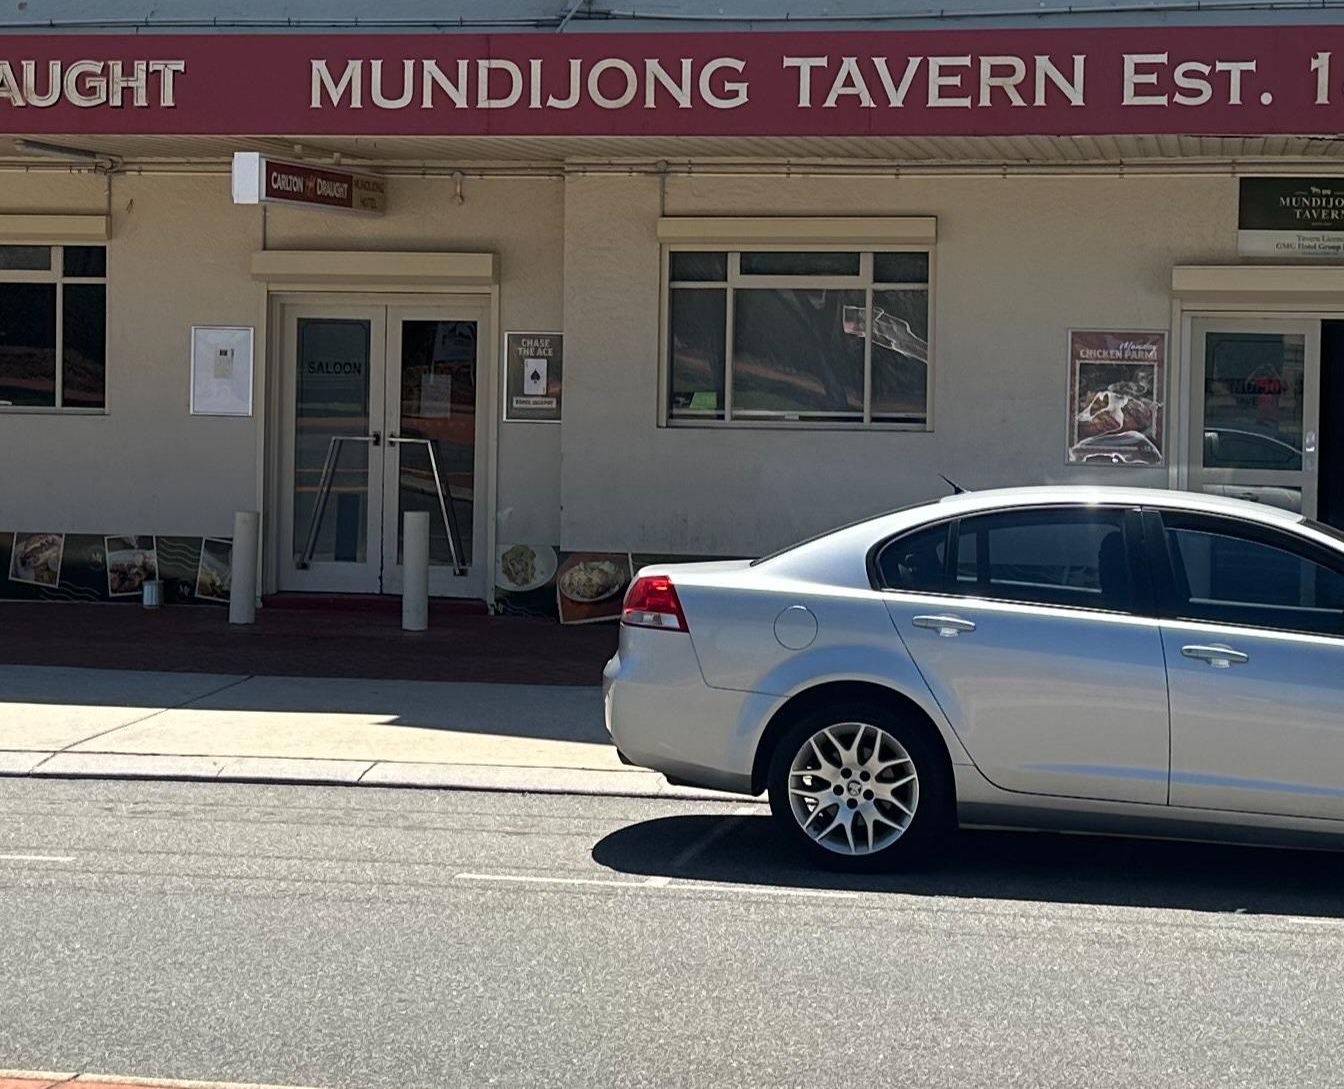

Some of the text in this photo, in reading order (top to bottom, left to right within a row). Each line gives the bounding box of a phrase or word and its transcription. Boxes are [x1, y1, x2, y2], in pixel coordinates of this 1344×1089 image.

[310, 57, 749, 109] MUNDIJONG
[782, 53, 1086, 109] TAVERN
[271, 171, 348, 199] CARLTON DRAUGHT
[521, 338, 551, 347] CHASE
[518, 347, 553, 357] THE ACE
[1079, 349, 1123, 359] CHICKEN
[307, 360, 362, 375] SALOON
